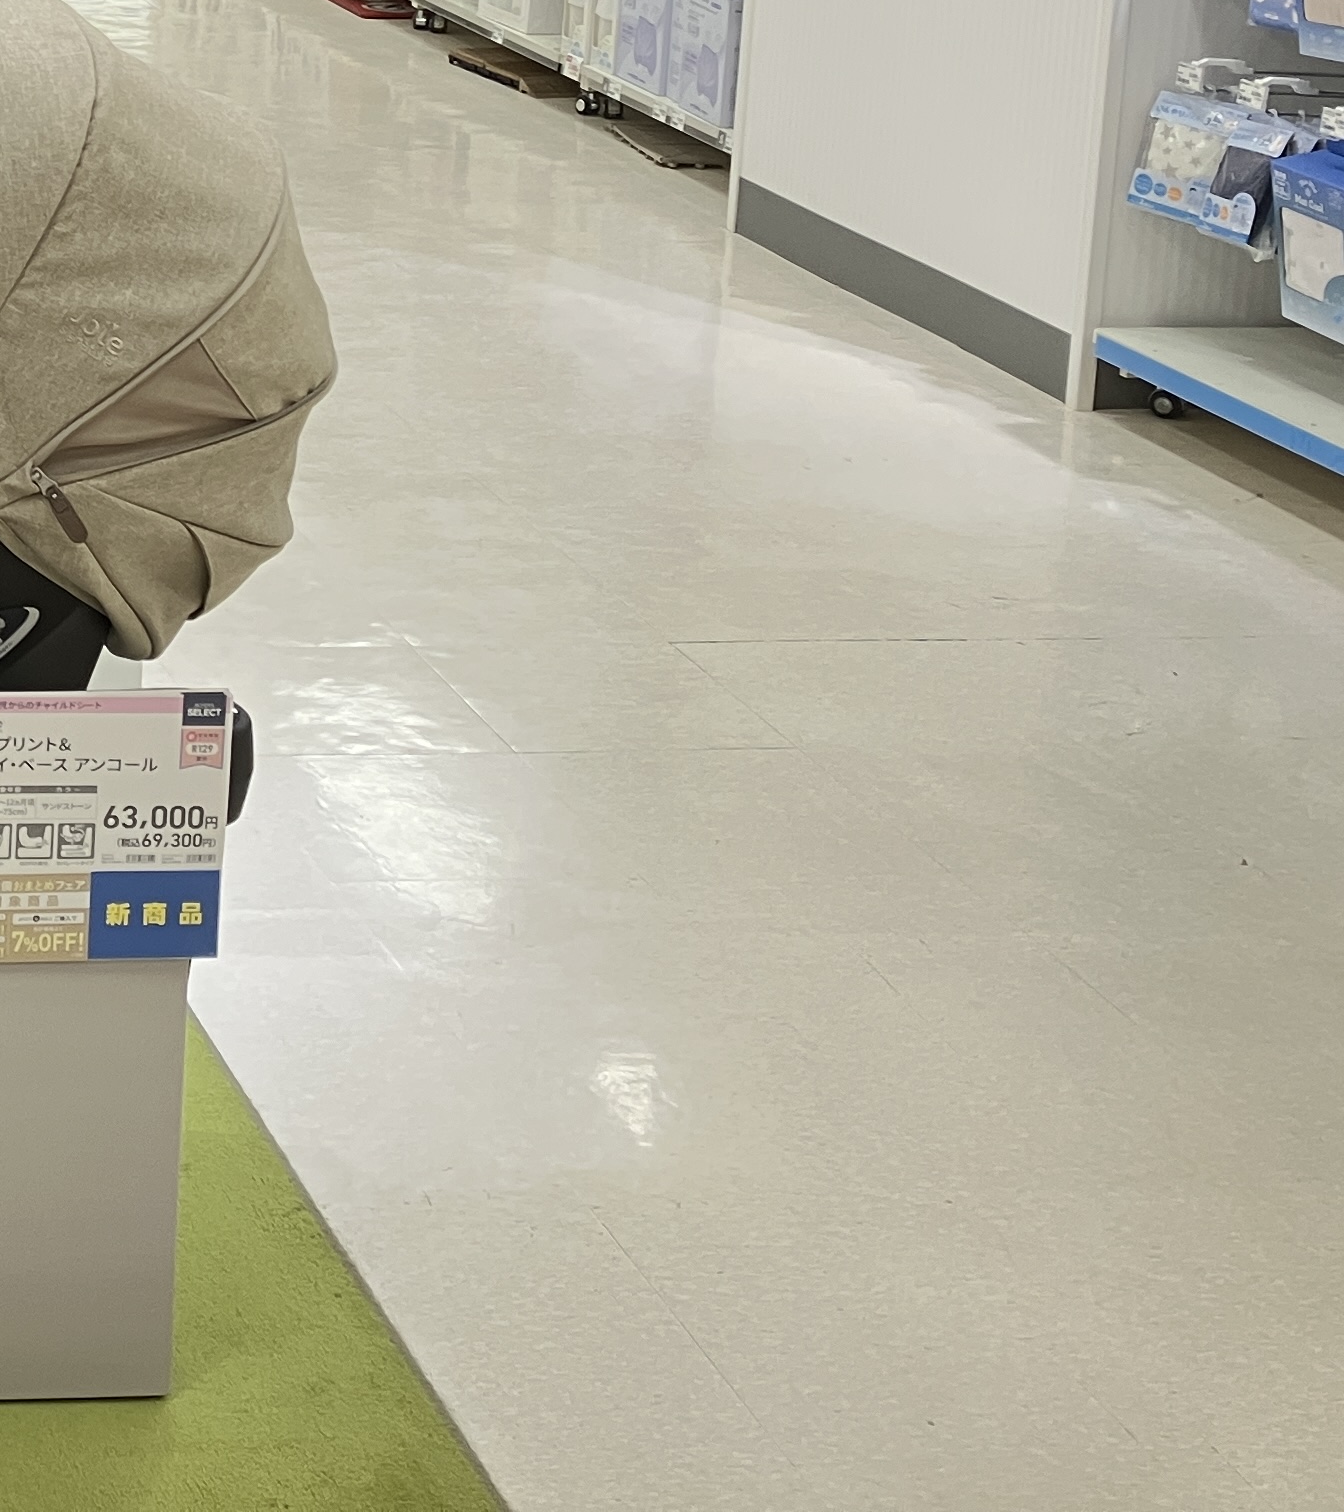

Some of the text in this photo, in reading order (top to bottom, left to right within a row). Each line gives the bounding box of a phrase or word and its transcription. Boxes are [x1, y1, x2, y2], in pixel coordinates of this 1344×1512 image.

[187, 708, 221, 717] SELECT
[74, 757, 158, 773] アンコール
[103, 805, 219, 831] 63,000円
[105, 901, 203, 927] 新商品
[12, 931, 85, 953] 7%OFF!
